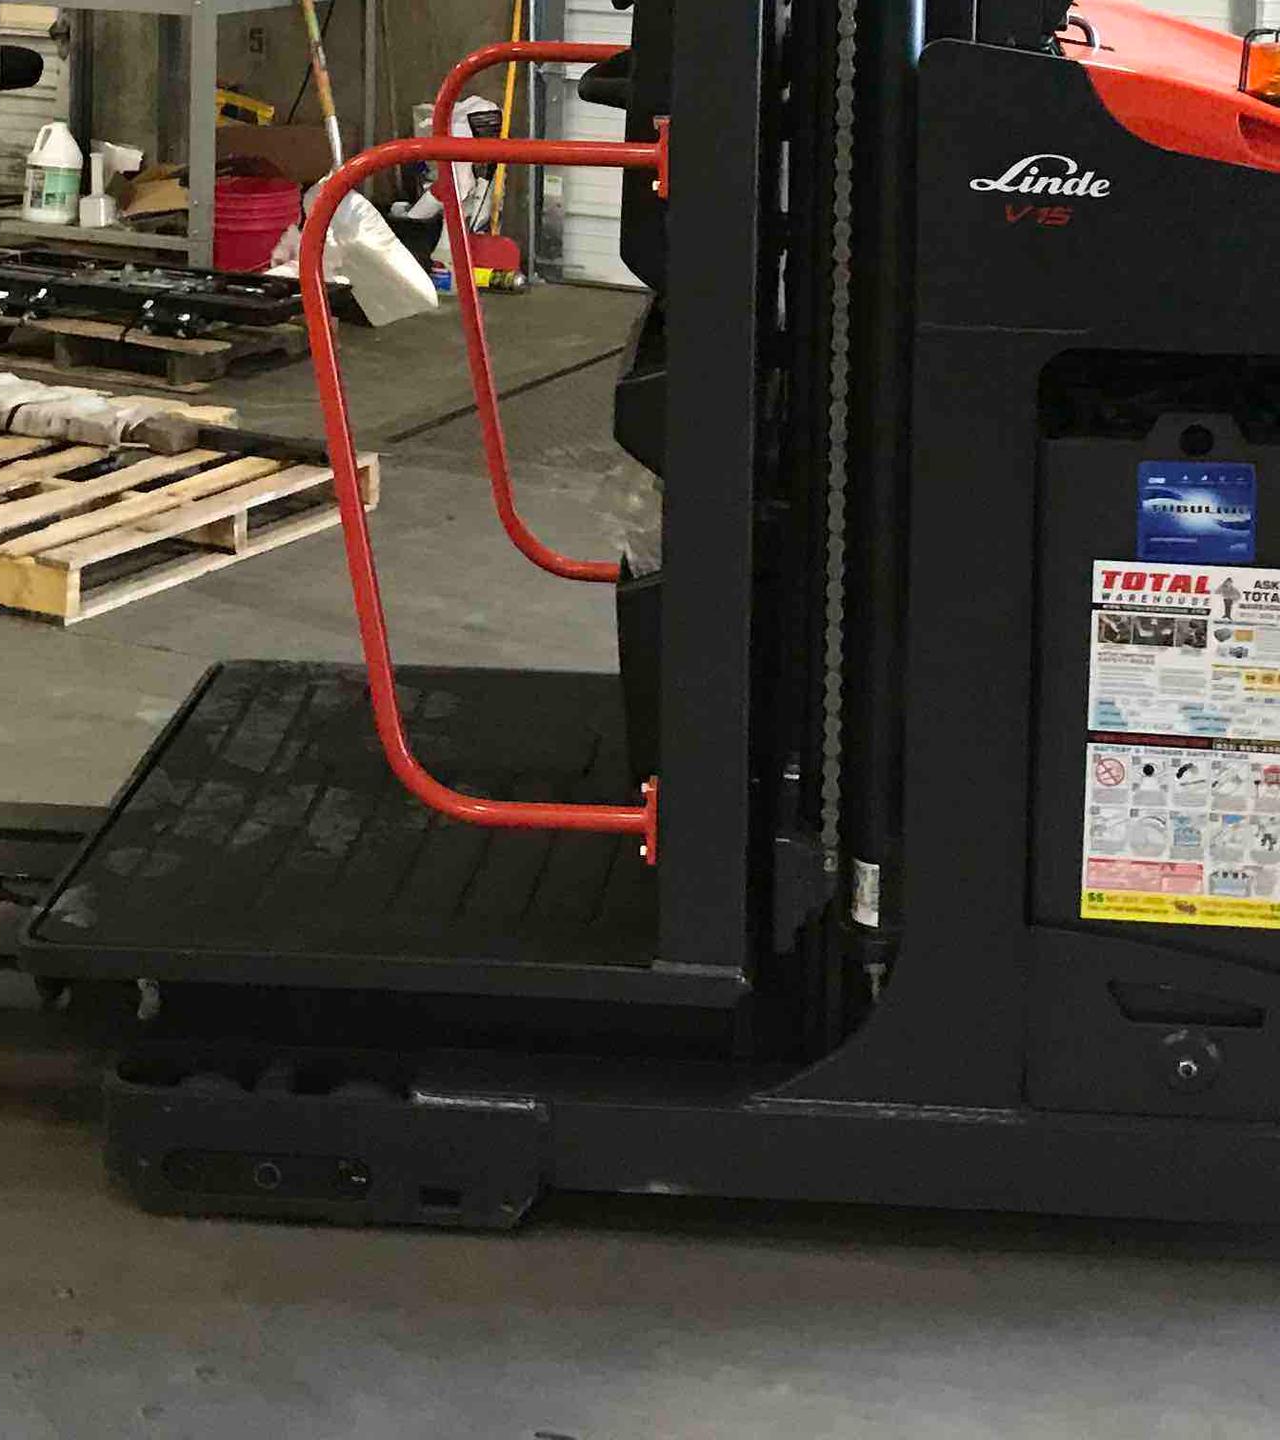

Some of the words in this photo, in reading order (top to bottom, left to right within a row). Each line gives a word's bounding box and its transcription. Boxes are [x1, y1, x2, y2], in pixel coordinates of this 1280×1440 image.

[969, 153, 1111, 198] Linde
[1102, 570, 1211, 594] TOTAL
[1253, 580, 1280, 590] ASK
[1102, 592, 1210, 607] WAREHOUSE
